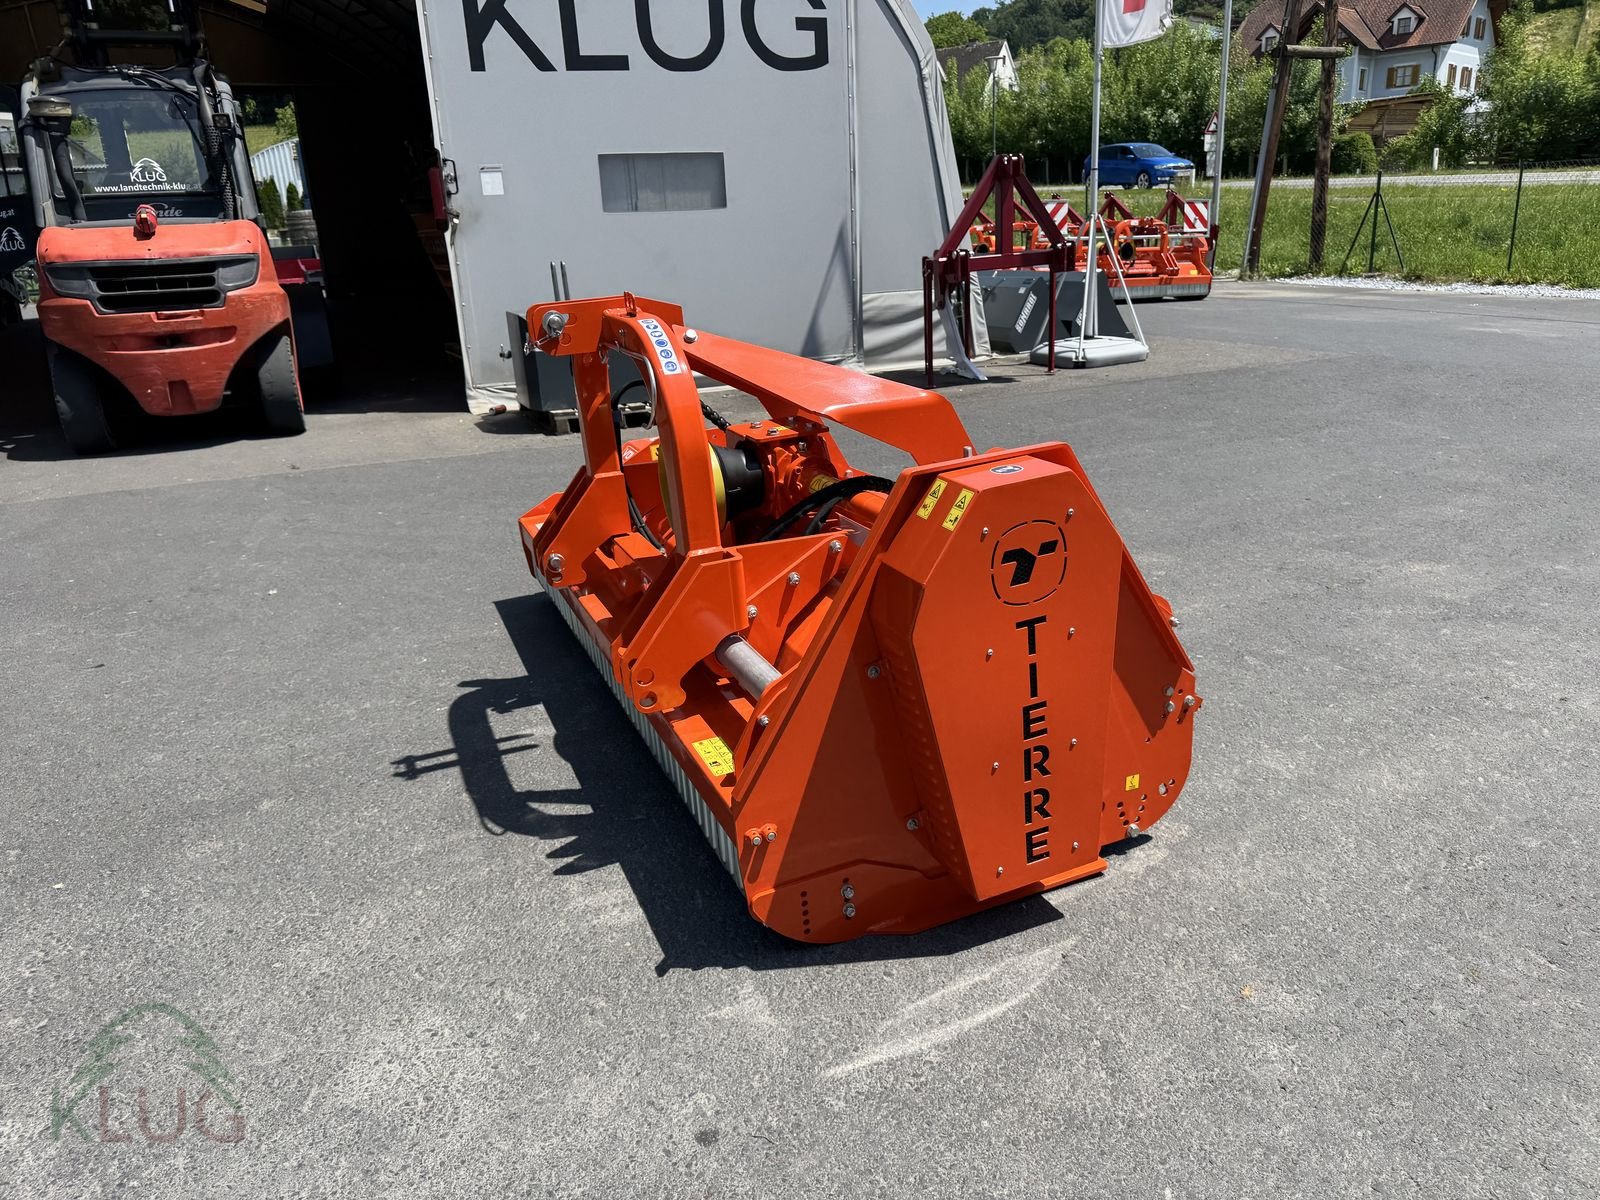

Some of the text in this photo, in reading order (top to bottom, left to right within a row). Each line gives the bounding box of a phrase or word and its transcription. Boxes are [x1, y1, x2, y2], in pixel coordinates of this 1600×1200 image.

[462, 0, 829, 72] KLUG
[94, 182, 202, 192] www.landtechnik-klug.at
[129, 171, 167, 182] KLUG
[1015, 615, 1052, 865] TIERRE
